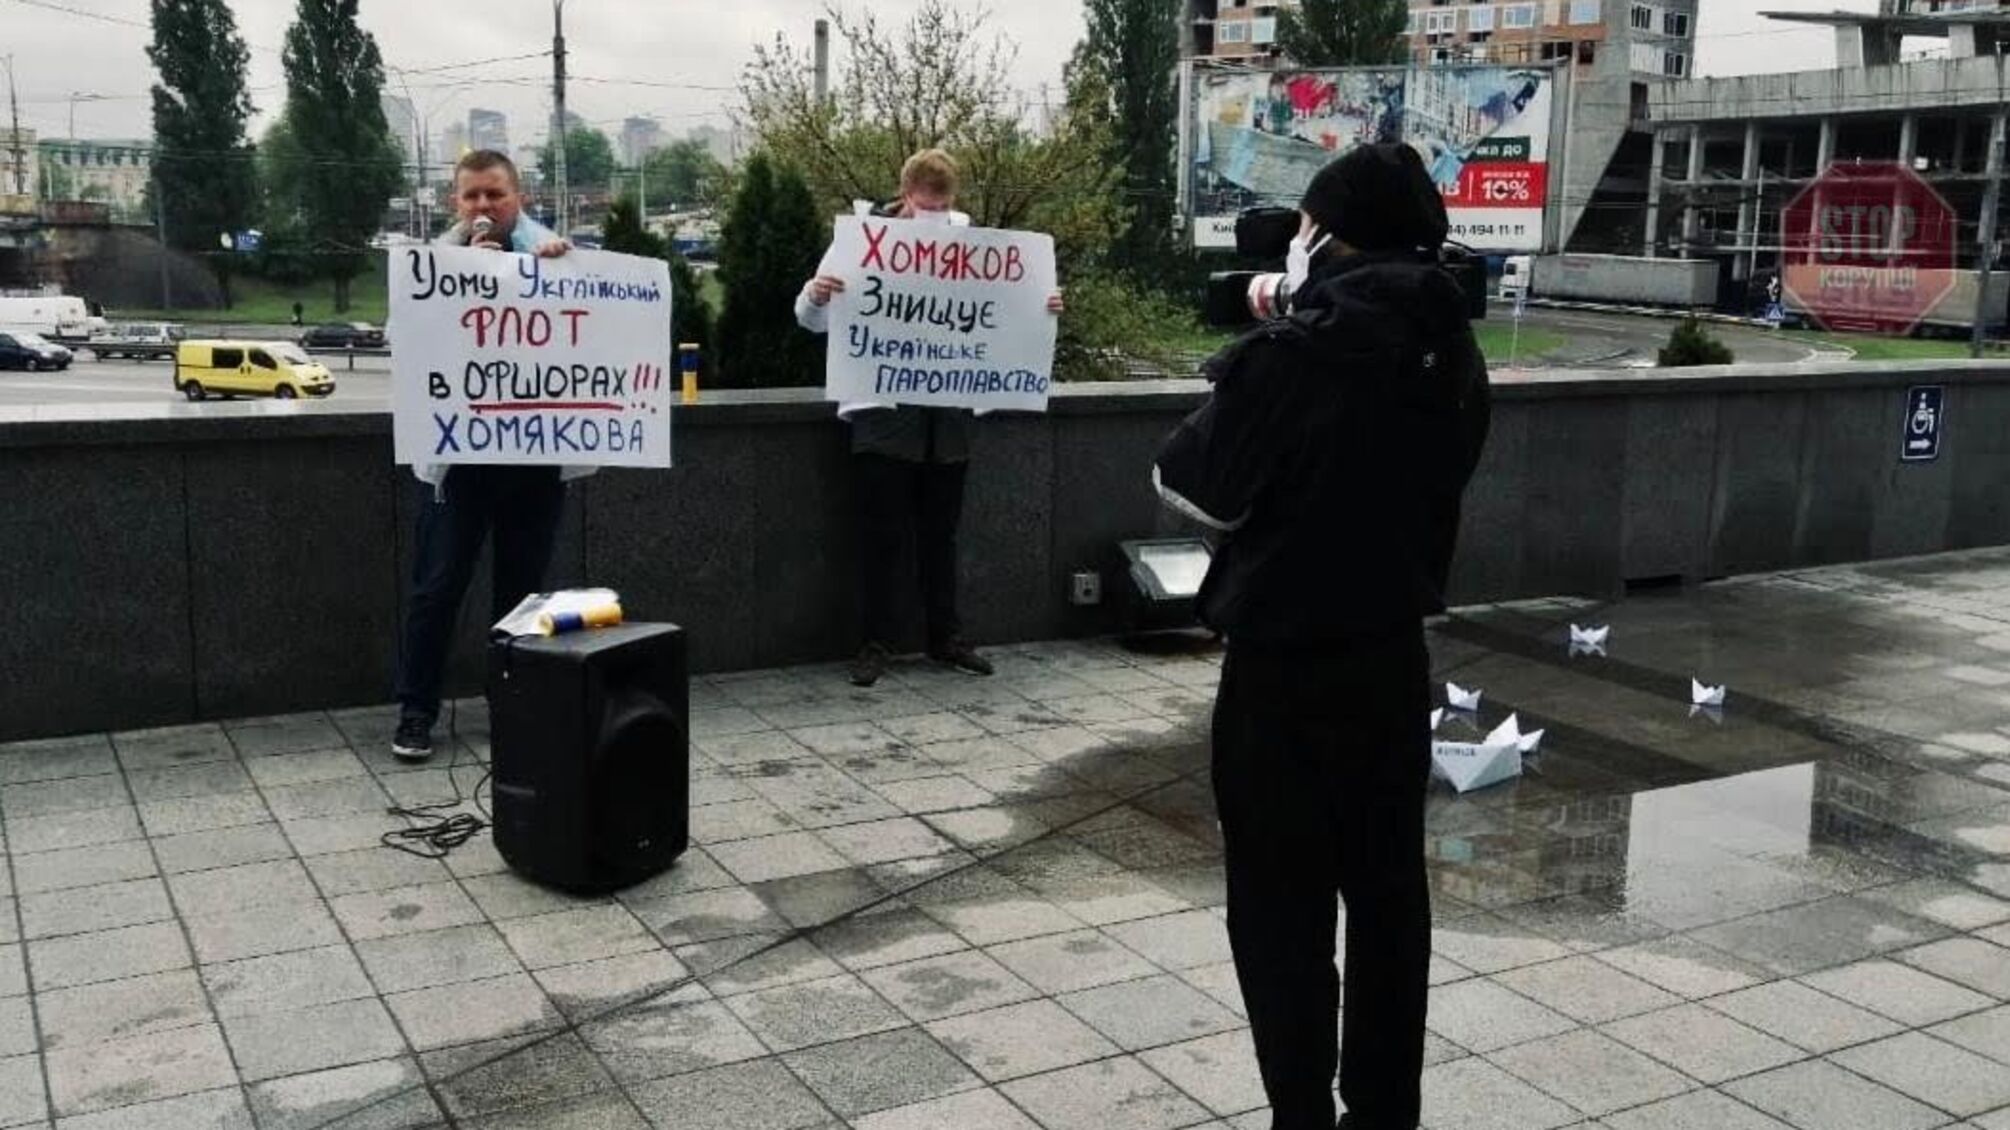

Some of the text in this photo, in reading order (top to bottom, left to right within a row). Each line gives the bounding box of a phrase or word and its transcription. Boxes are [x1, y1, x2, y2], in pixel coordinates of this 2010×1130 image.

[1481, 180, 1530, 200] 10%
[1469, 224, 1493, 236] 494
[460, 306, 590, 348] ФЛОТ
[875, 364, 1050, 394] ПАРОПЛАВСТВО
[433, 411, 644, 455] ХОМЯКОВА
